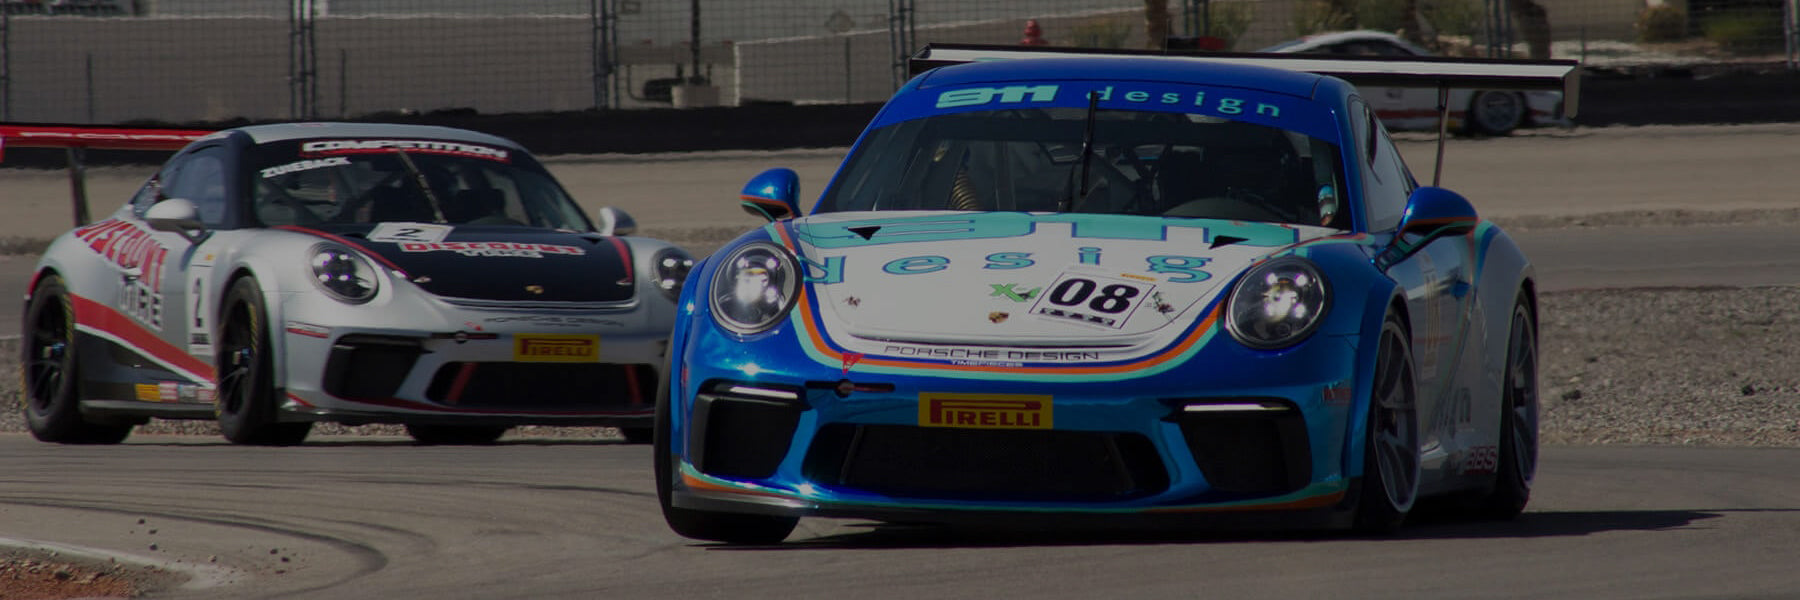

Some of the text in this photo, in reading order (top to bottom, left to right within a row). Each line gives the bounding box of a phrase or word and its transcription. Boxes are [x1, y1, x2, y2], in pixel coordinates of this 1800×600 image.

[937, 84, 1282, 117] 911 design
[392, 228, 425, 239] 2
[74, 218, 168, 294] DISCOUNT
[403, 242, 586, 255] DISCOUNT
[192, 277, 204, 328] 2
[1048, 278, 1140, 314] 08
[521, 338, 593, 357] PIRELLI
[884, 346, 1100, 361] PORSCHE DESIGN
[949, 359, 1024, 368] TIMEPIECES
[929, 399, 1042, 427] PIRELLI
